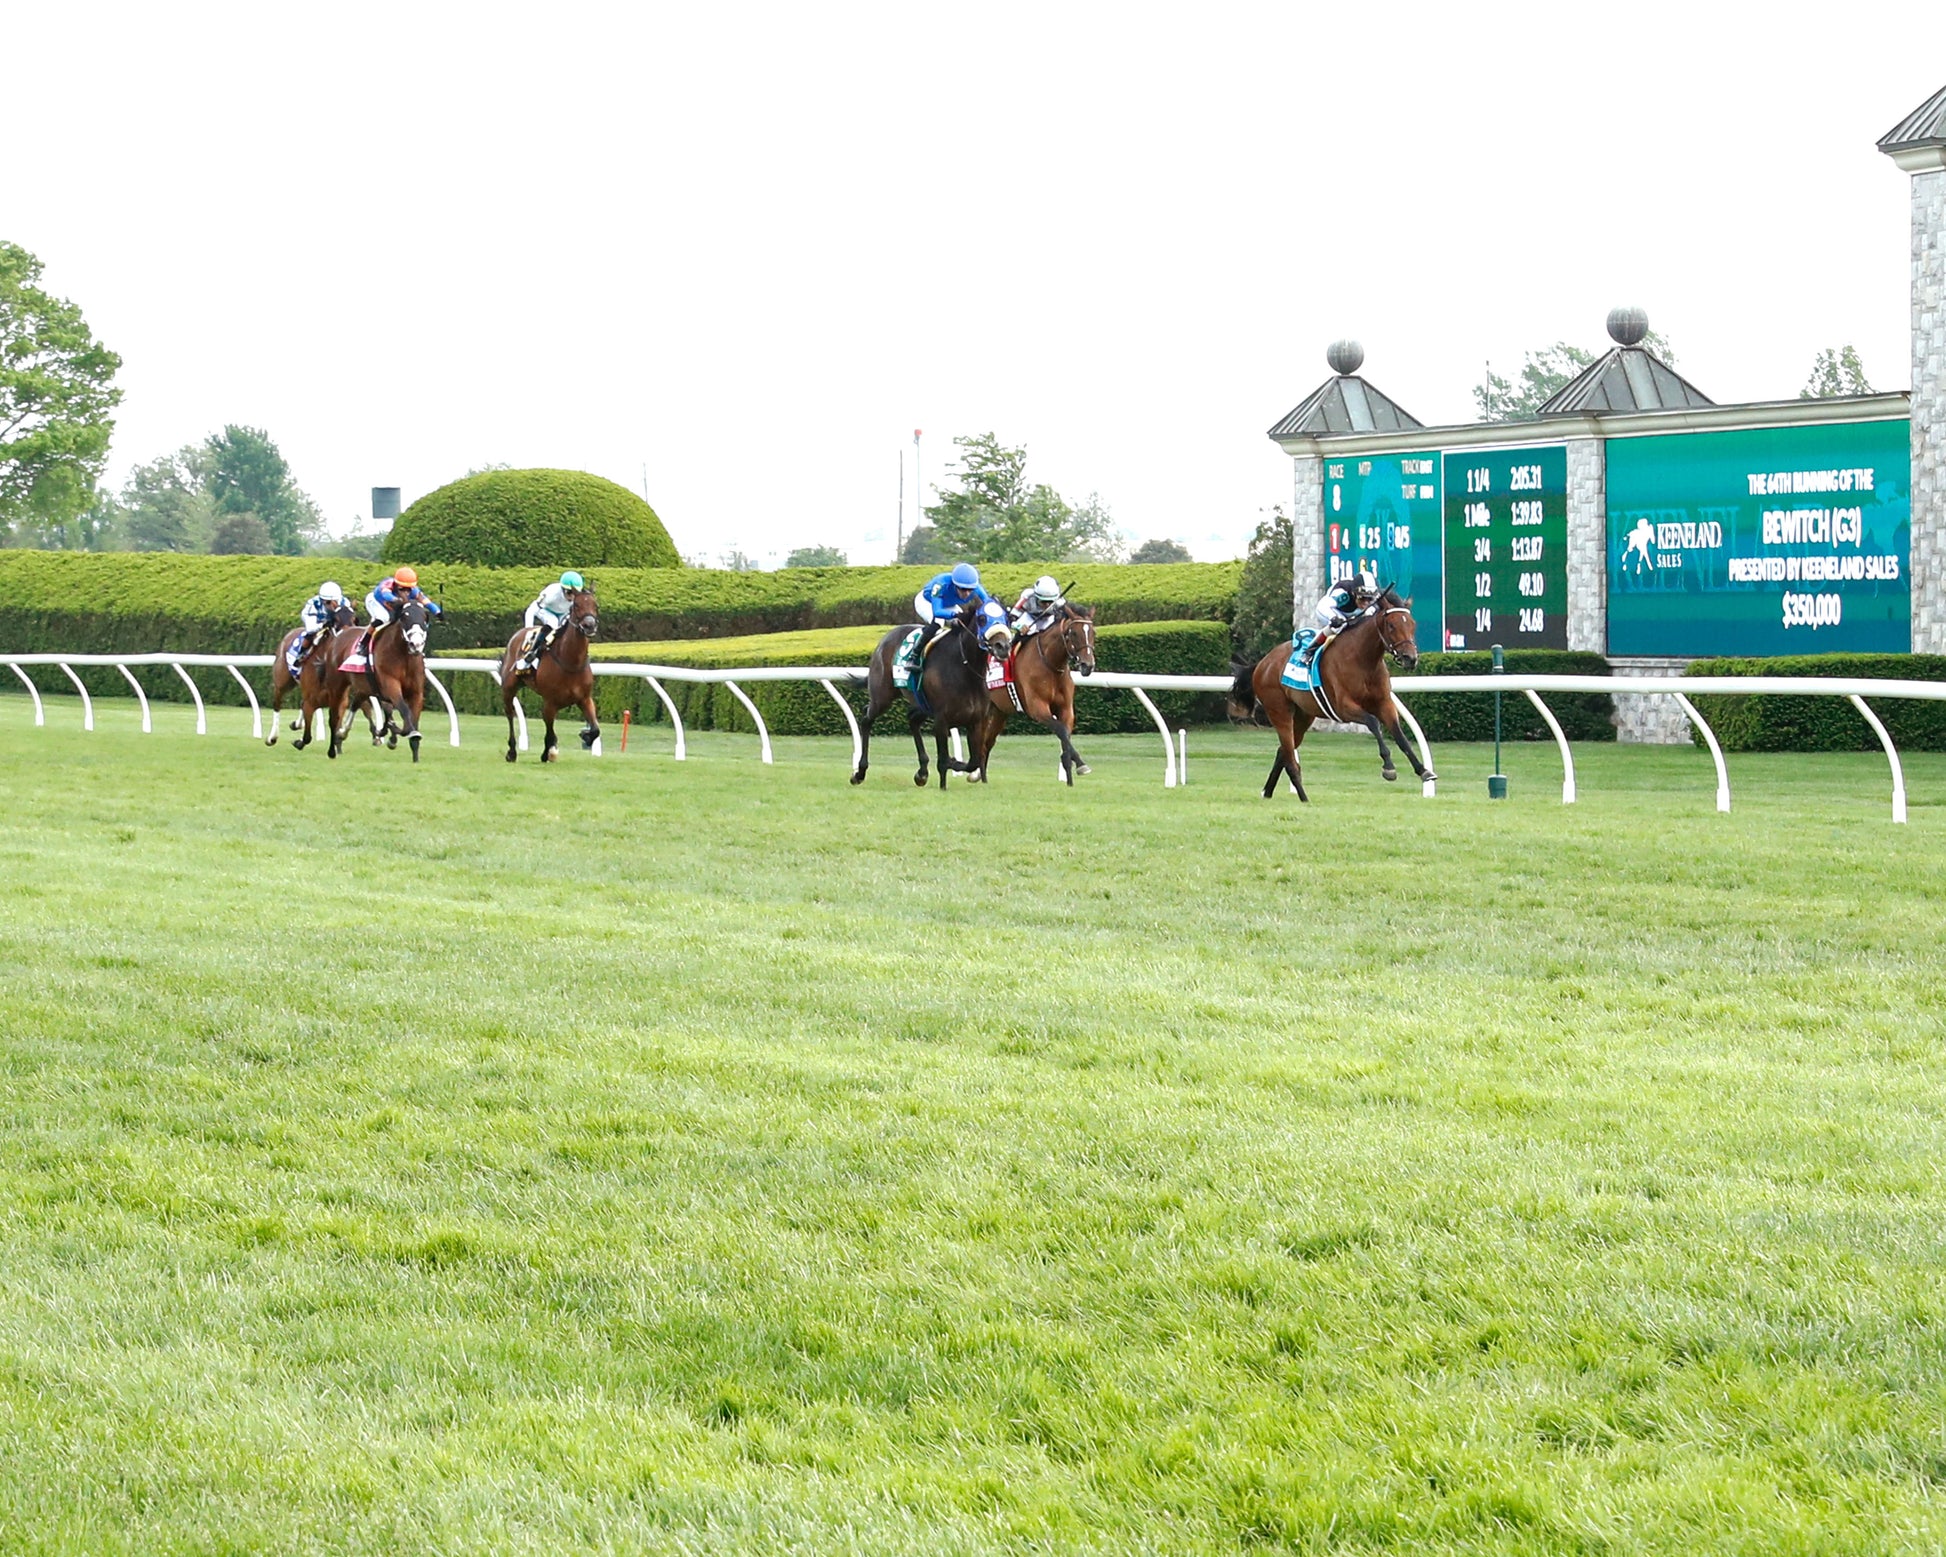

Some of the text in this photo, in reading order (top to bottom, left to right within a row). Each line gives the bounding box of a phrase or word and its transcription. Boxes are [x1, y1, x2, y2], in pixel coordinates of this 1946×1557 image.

[1329, 464, 1344, 479] RACE
[1401, 459, 1420, 474] TRACK
[1510, 465, 1542, 490] 2:05.31
[1401, 484, 1416, 499] TURF
[1467, 467, 1490, 492] 1 1/4
[1747, 468, 1874, 496] THE 64TH RUNNING OF THE
[1333, 484, 1341, 511] 8
[1464, 504, 1470, 527] 1
[1511, 501, 1542, 526] 1:39.83
[1342, 528, 1349, 549] 4
[1367, 527, 1380, 549] 25
[1657, 521, 1722, 549] KEENELAND
[1763, 506, 1862, 548] BEWITCH (G3)
[1474, 537, 1490, 562] 3/4
[1511, 536, 1543, 561] 1:13.87
[1657, 553, 1682, 568] SALES
[1729, 555, 1899, 581] PRESENTED BY KEENELAND SALES
[1475, 572, 1491, 597] 1/2
[1518, 572, 1544, 597] 49.10
[1475, 607, 1491, 632] 1/4
[1519, 608, 1544, 632] 24.68
[1782, 590, 1841, 631] $350,000
